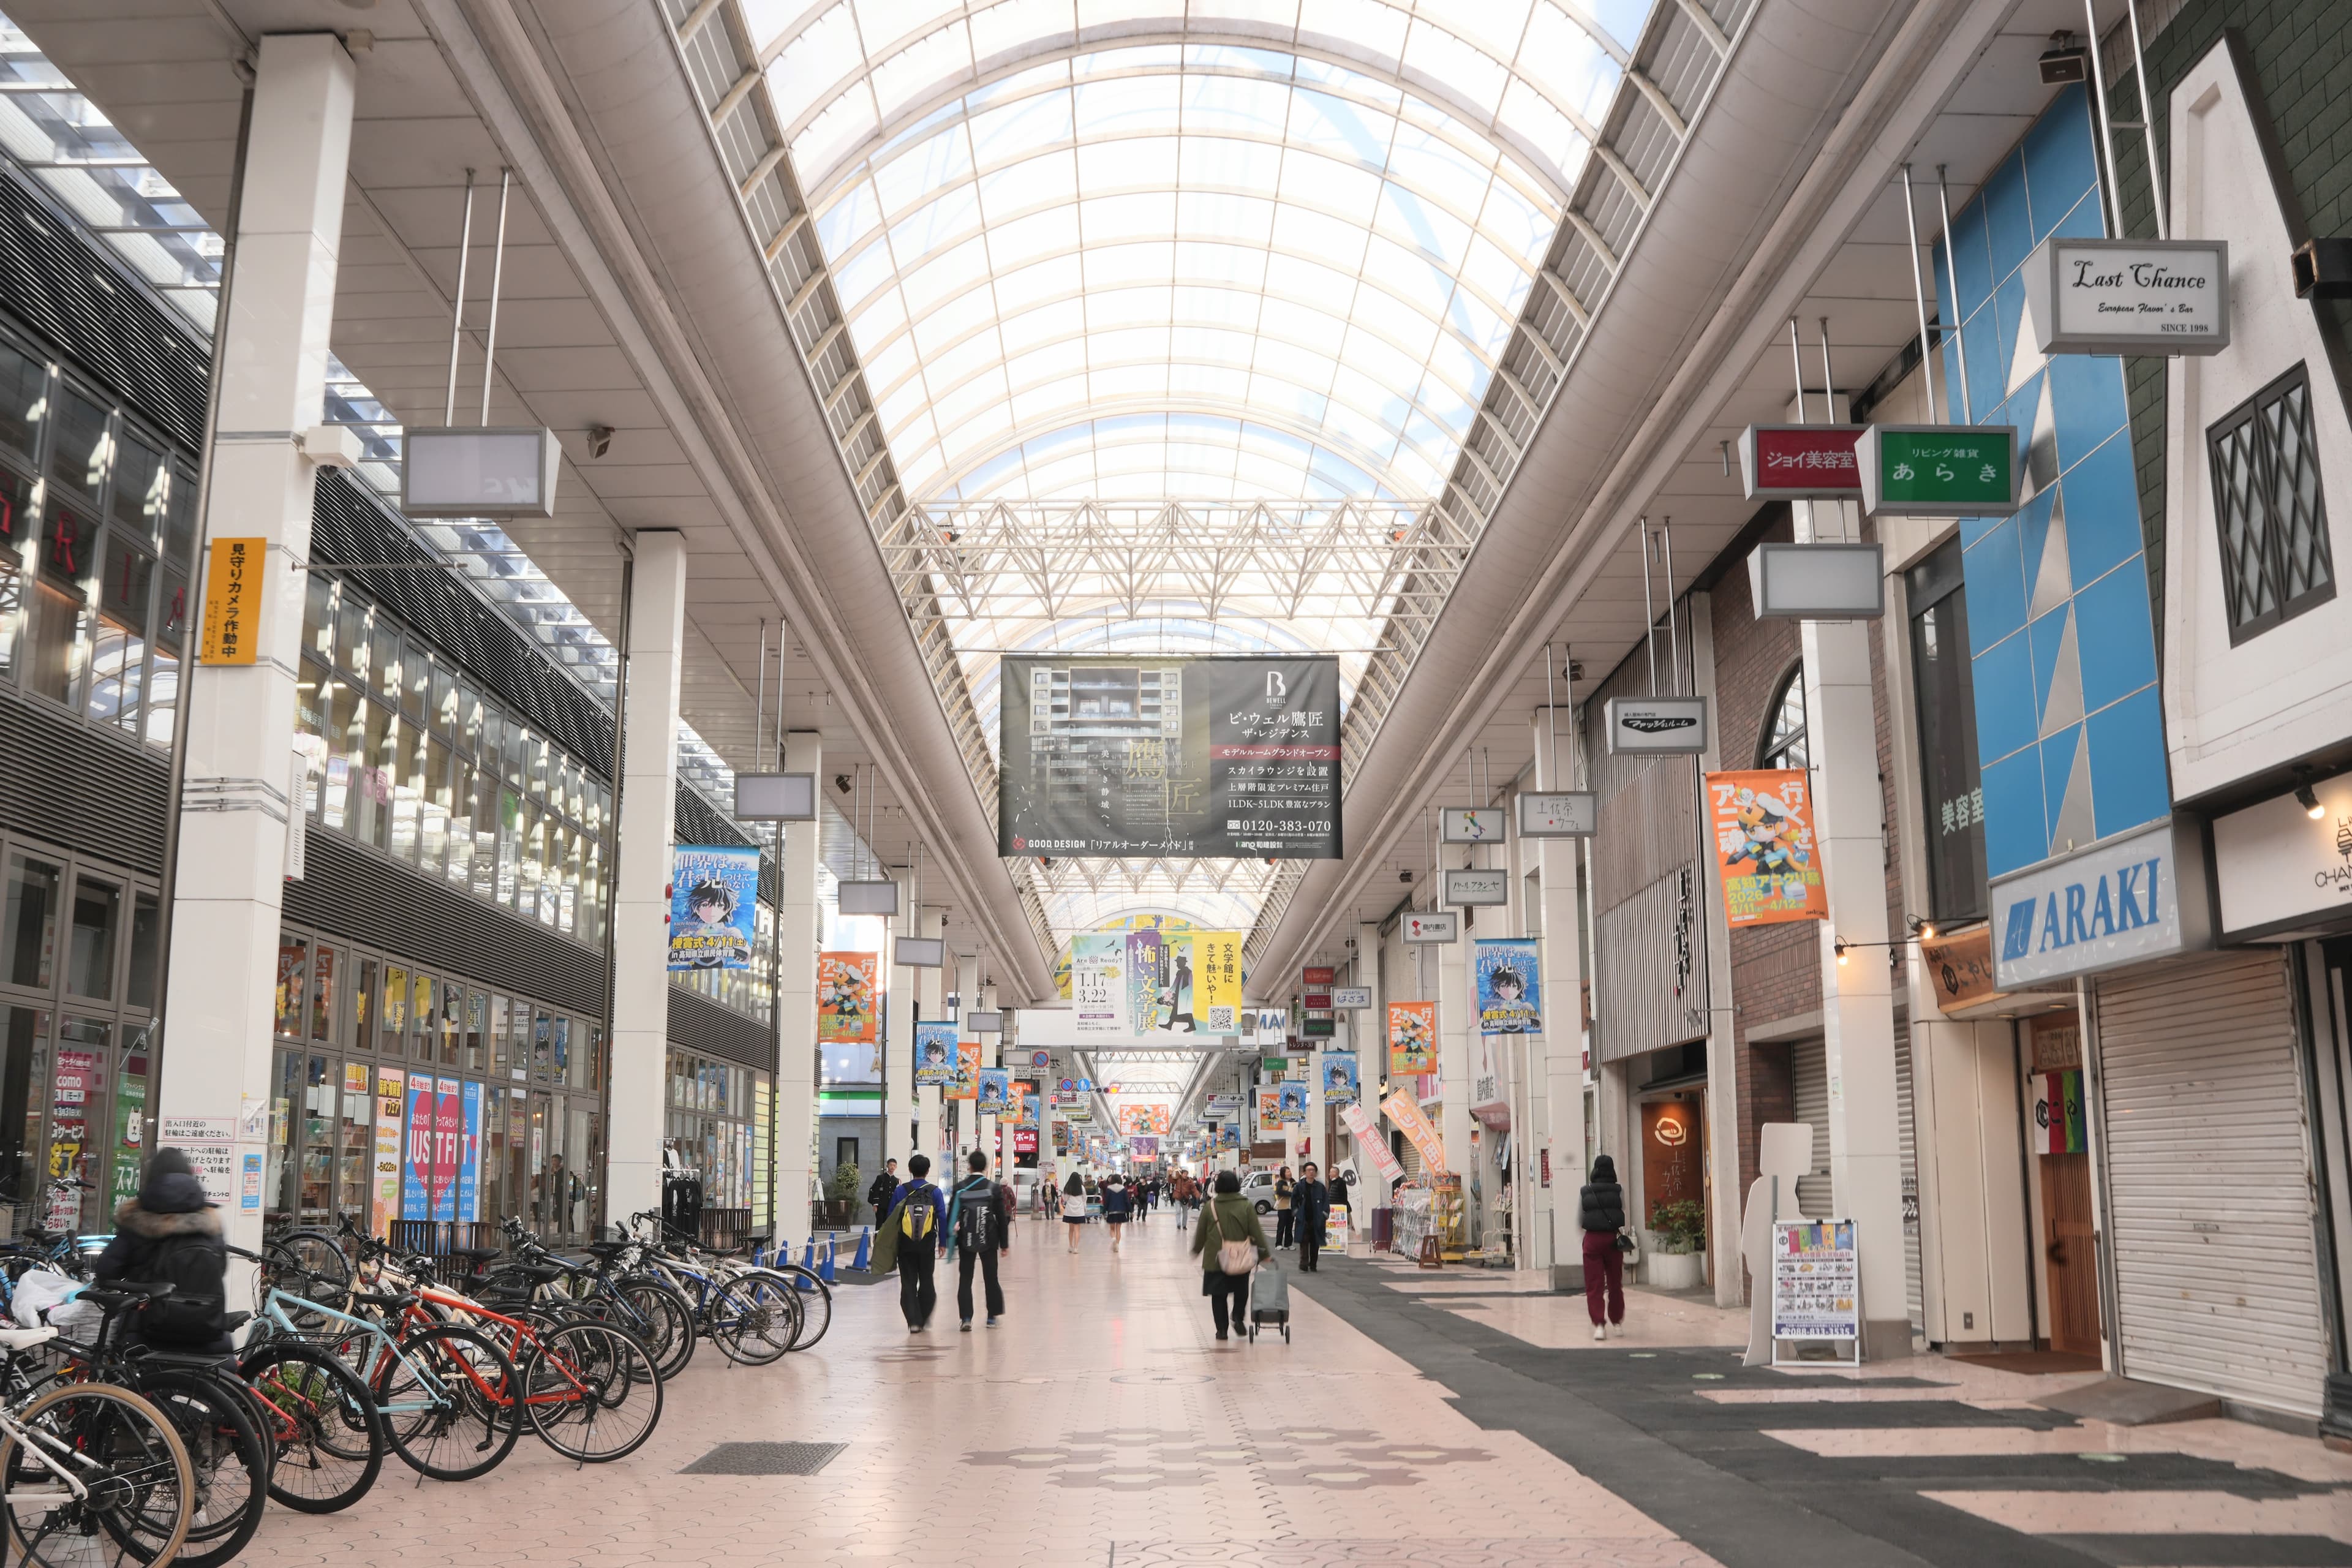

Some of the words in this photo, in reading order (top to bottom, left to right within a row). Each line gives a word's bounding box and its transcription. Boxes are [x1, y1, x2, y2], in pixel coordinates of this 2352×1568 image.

[2073, 260, 2124, 288] Last
[2129, 263, 2205, 288] Chance
[2098, 303, 2134, 314] European
[2179, 304, 2193, 313] Bar
[1767, 451, 1855, 469] ジョイ美容室
[1912, 448, 1979, 458] リビング雑貨
[1893, 462, 1997, 482] あらき
[221, 543, 246, 658] 見守りカメラ作動中
[1229, 711, 1323, 726] ビ・ウェル鷹匠
[1242, 728, 1310, 738] ザ・レジデンス
[1222, 748, 1330, 757] モデルルームグランドオープン
[1228, 766, 1329, 777] スカイラウンジを設置
[1228, 783, 1329, 792] 上層階限定プレミアム住戸
[1779, 782, 1812, 850] 行くぜ
[1941, 787, 1984, 837] 美容室
[1242, 820, 1331, 831] 0120-383-070
[1556, 816, 1580, 830] カフェ
[1028, 840, 1052, 848] GOOD
[1054, 840, 1085, 848] DESIGN
[679, 854, 750, 870] 世界はまだ、
[1725, 872, 1821, 892] 高知アニクリ祭
[1728, 889, 1765, 904] 2026
[2039, 858, 2161, 953] ARAKI
[671, 937, 704, 949] 授賞式
[1224, 943, 1234, 983] 文学館に
[1080, 973, 1106, 987] 1.17
[1135, 938, 1158, 1031] 怖い文学展
[1079, 989, 1106, 1003] 3.22
[56, 1076, 81, 1088] como
[410, 1077, 431, 1090] 4月始まり
[439, 1080, 458, 1093] 4月始まり
[1477, 1076, 1494, 1101] 島内書店
[165, 1129, 231, 1138] 駐輪はご遠慮ください。
